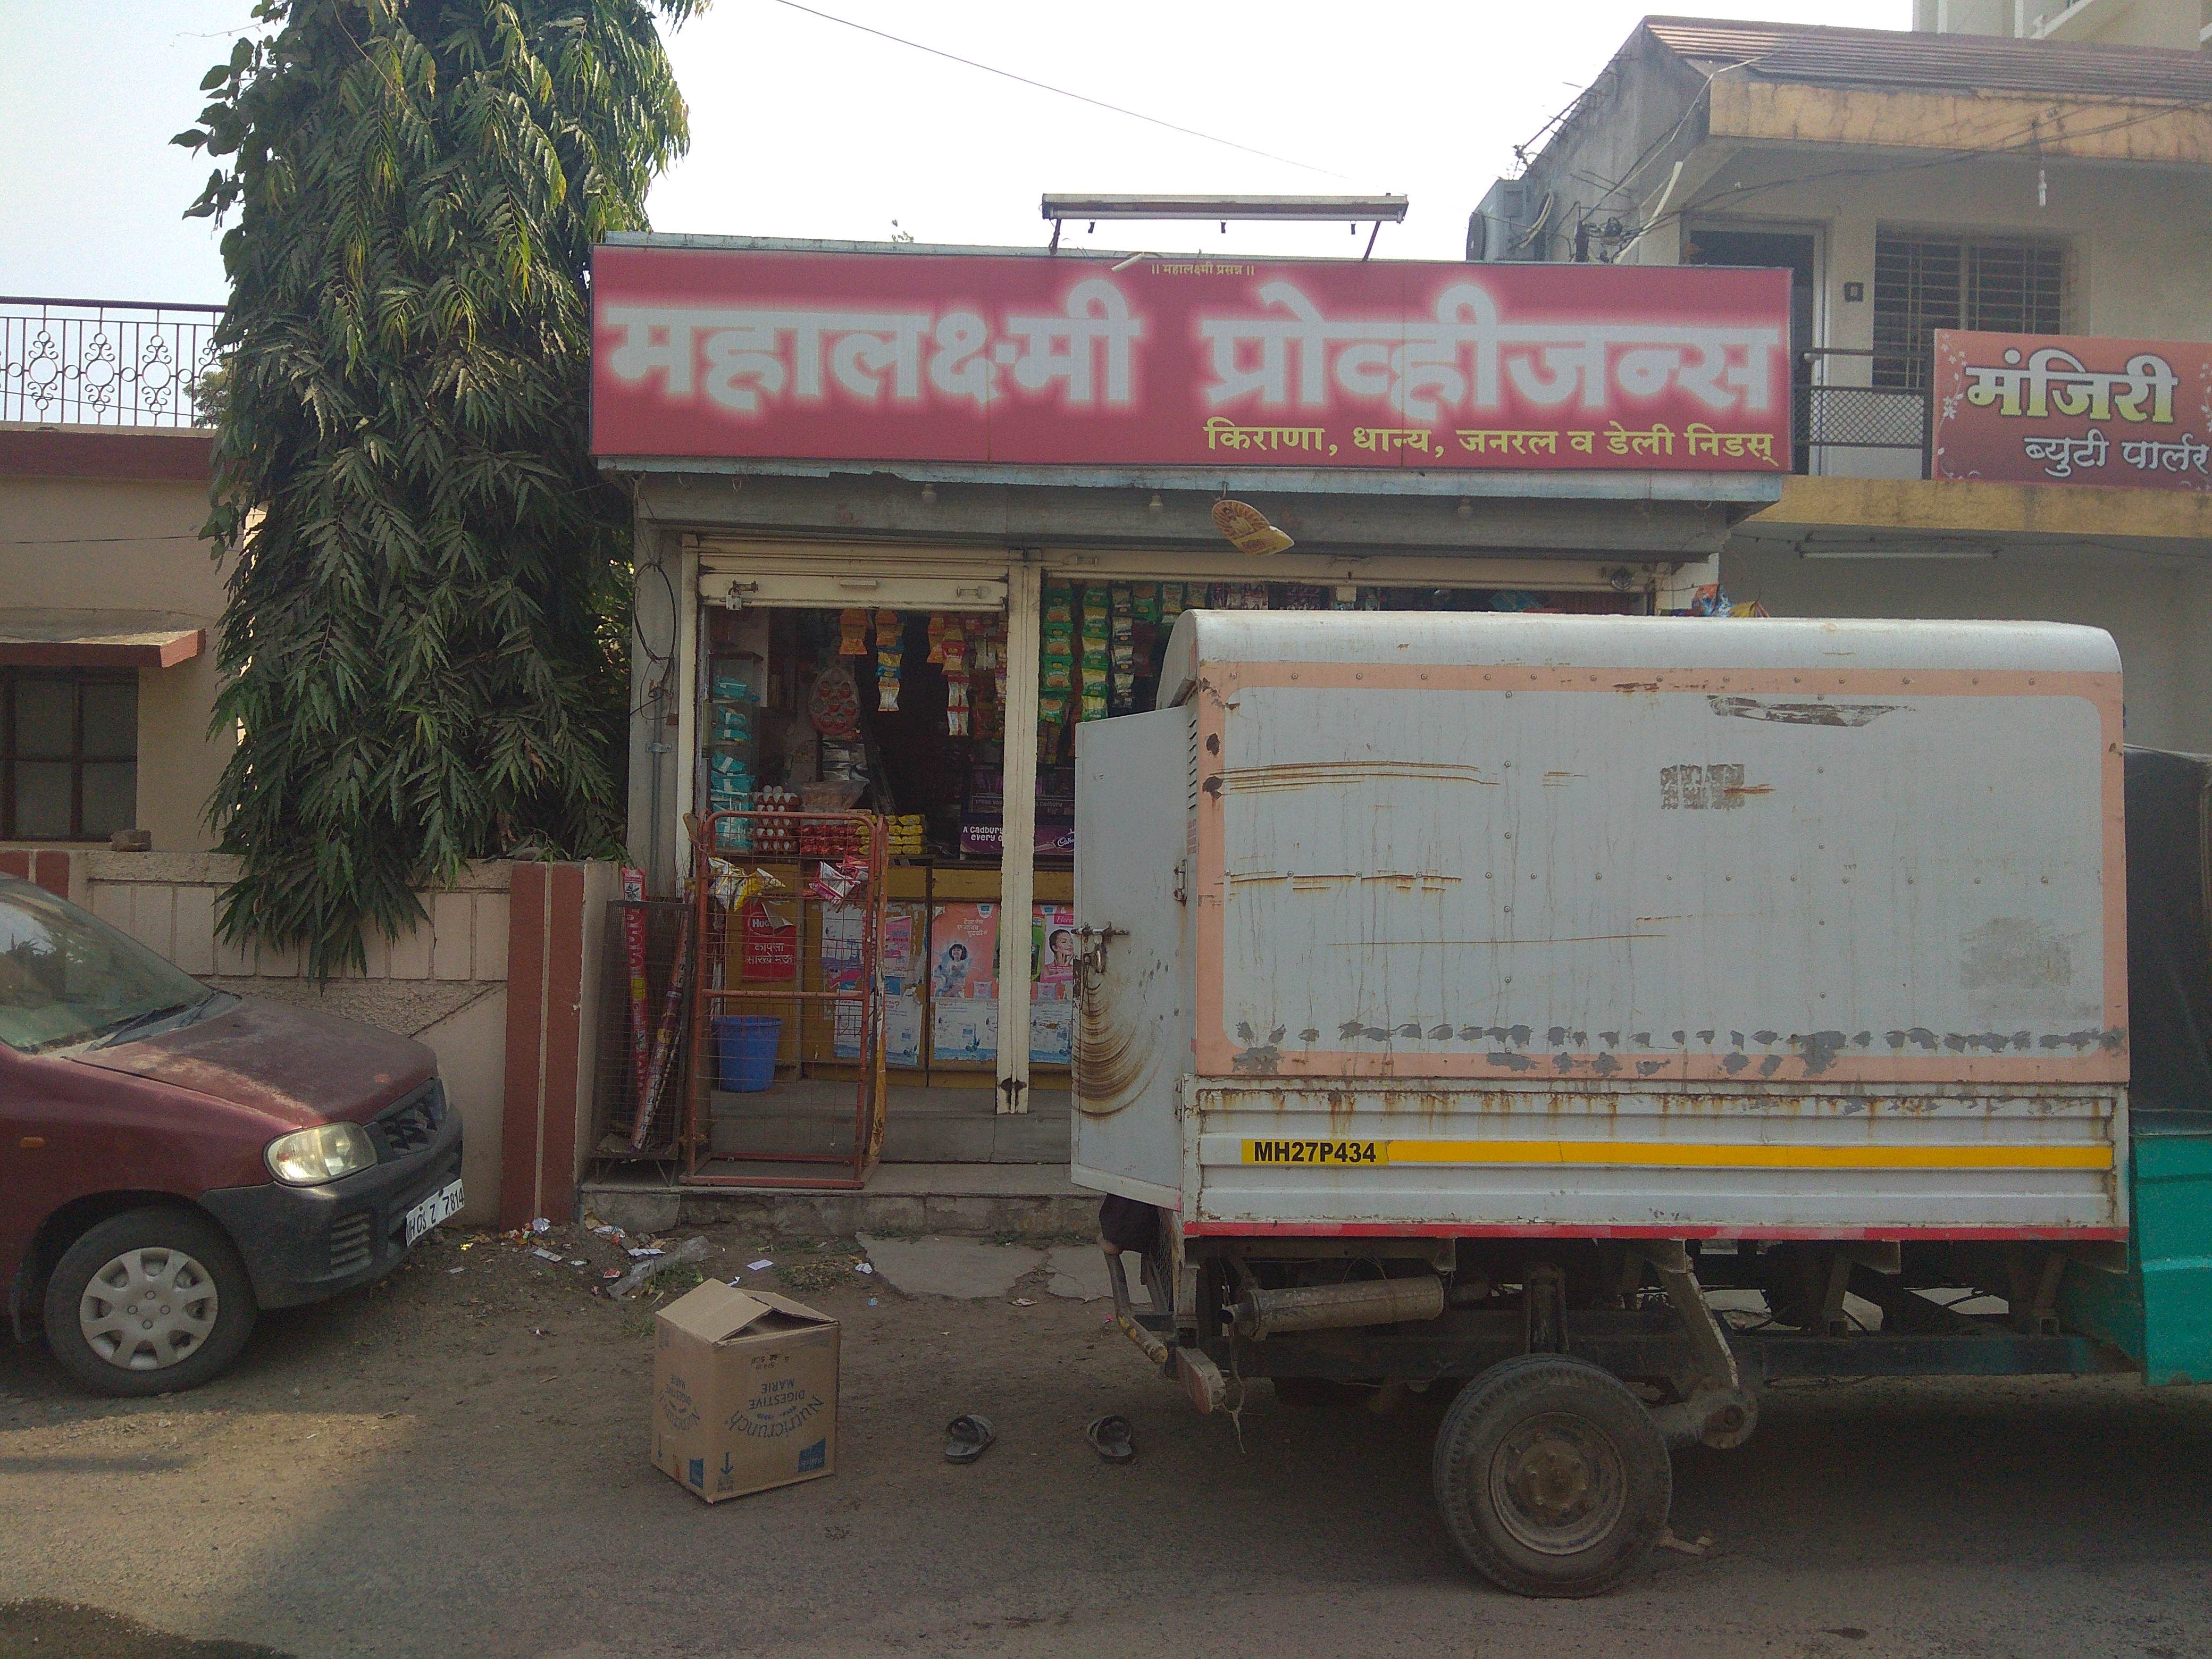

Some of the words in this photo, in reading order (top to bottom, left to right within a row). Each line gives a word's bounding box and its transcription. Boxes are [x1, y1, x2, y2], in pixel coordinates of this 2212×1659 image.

[606, 278, 1143, 412] महालक्ष्मी
[1200, 282, 1780, 422] प्रोव्हीजन्स
[1966, 348, 2179, 423] मंजिरी
[1203, 417, 1338, 456] किराणा,
[1353, 427, 1444, 458] धान्य,
[1456, 430, 1559, 456] जनरल
[1567, 431, 1595, 455] व
[1604, 421, 1675, 456] डेली
[1683, 423, 1779, 467] निडस्
[2024, 428, 2109, 477] ब्युटी
[2121, 432, 2211, 474] पार्लर
[1254, 1142, 1376, 1162] MH27P434
[430, 1203, 436, 1224] Z
[442, 1187, 464, 1216] 7814
[749, 1389, 805, 1410] DIGESTIVE
[761, 1378, 795, 1394] MARIE
[729, 1395, 824, 1438] Nutricrunch
